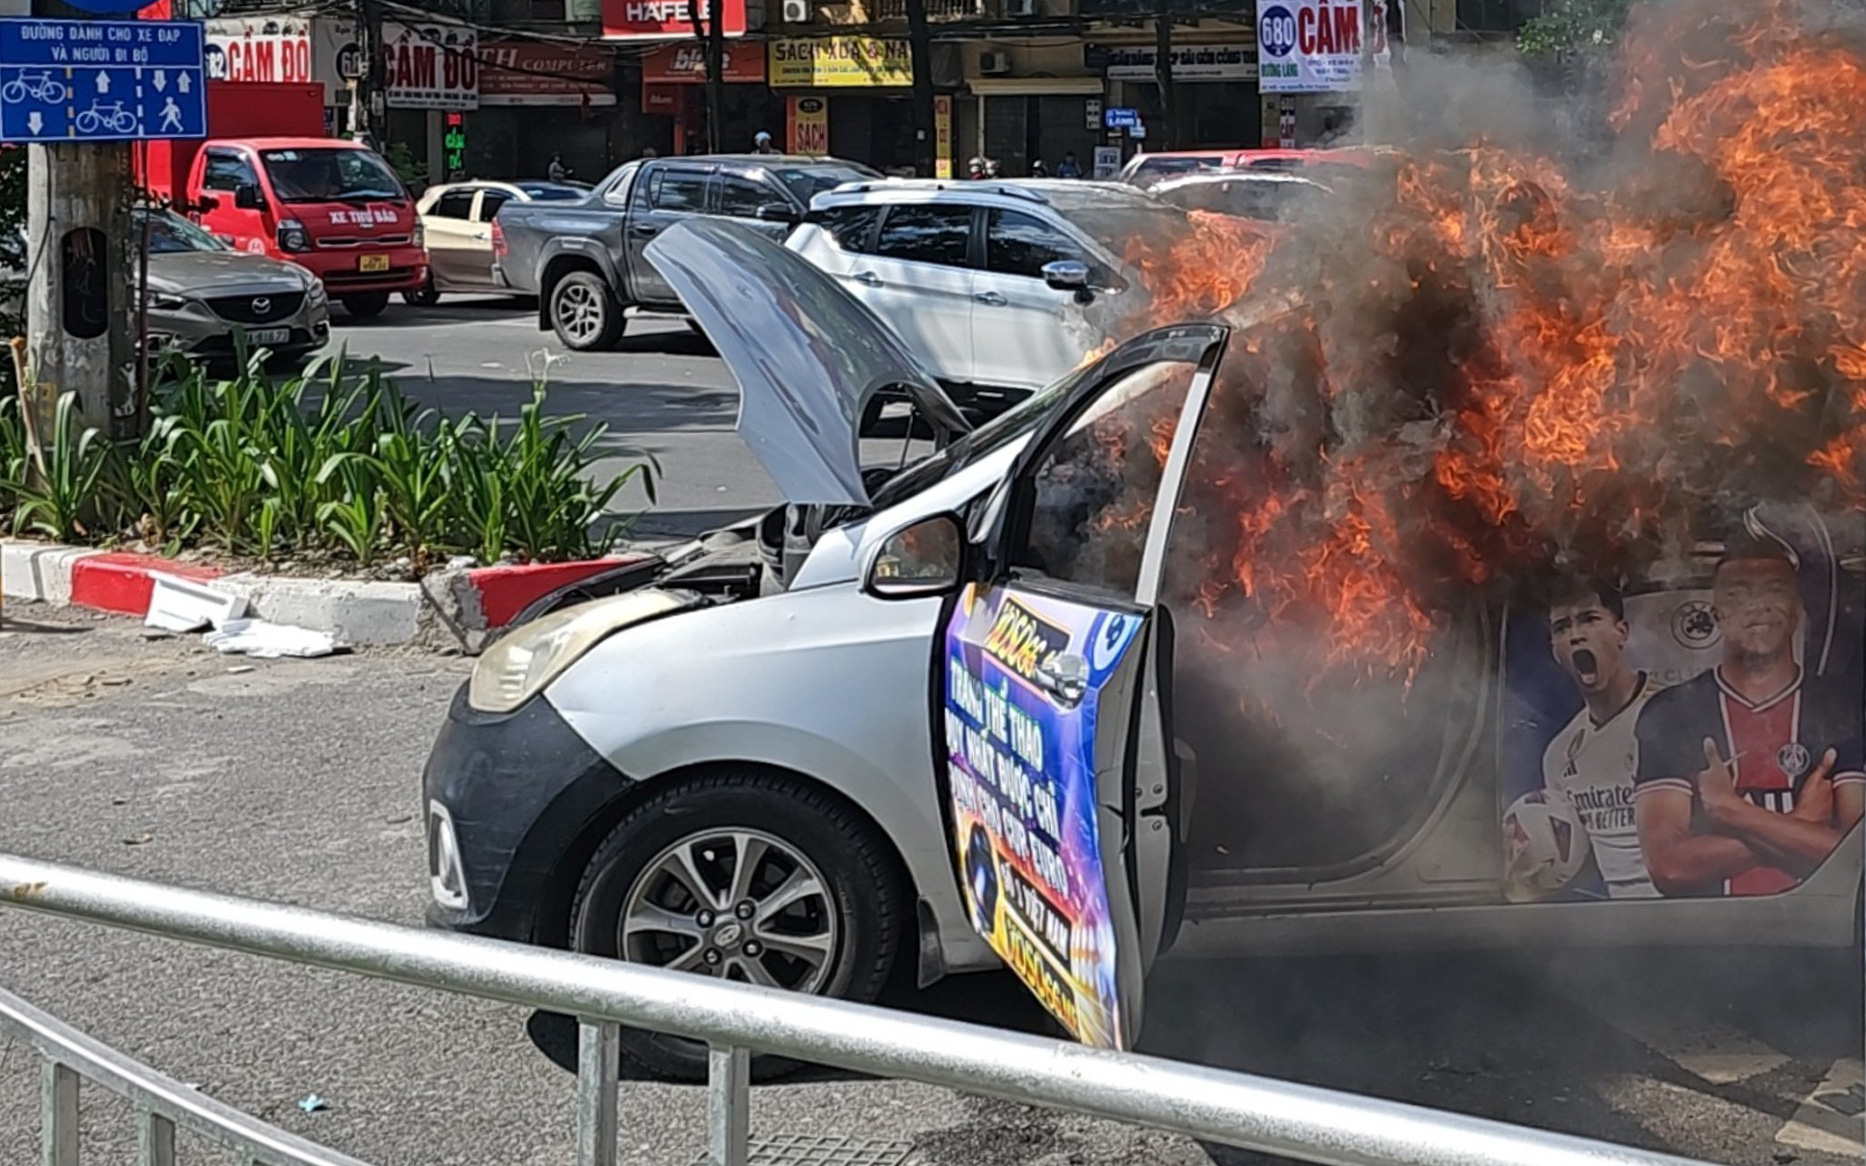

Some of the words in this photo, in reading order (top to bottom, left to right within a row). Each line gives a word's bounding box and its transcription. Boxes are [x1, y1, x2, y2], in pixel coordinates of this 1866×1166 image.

[21, 23, 63, 40] ĐƯỜNG
[69, 24, 103, 41] DÀNH
[107, 29, 131, 41] CHO
[137, 29, 152, 42] XE
[158, 29, 181, 46] ĐẠP
[1262, 17, 1294, 46] 680
[51, 43, 68, 61] VÀ
[73, 44, 109, 62] NGƯỜI
[115, 48, 127, 62] ĐI
[133, 47, 149, 65] BỘ
[329, 211, 348, 224] XE
[1028, 830, 1069, 900] EURO
